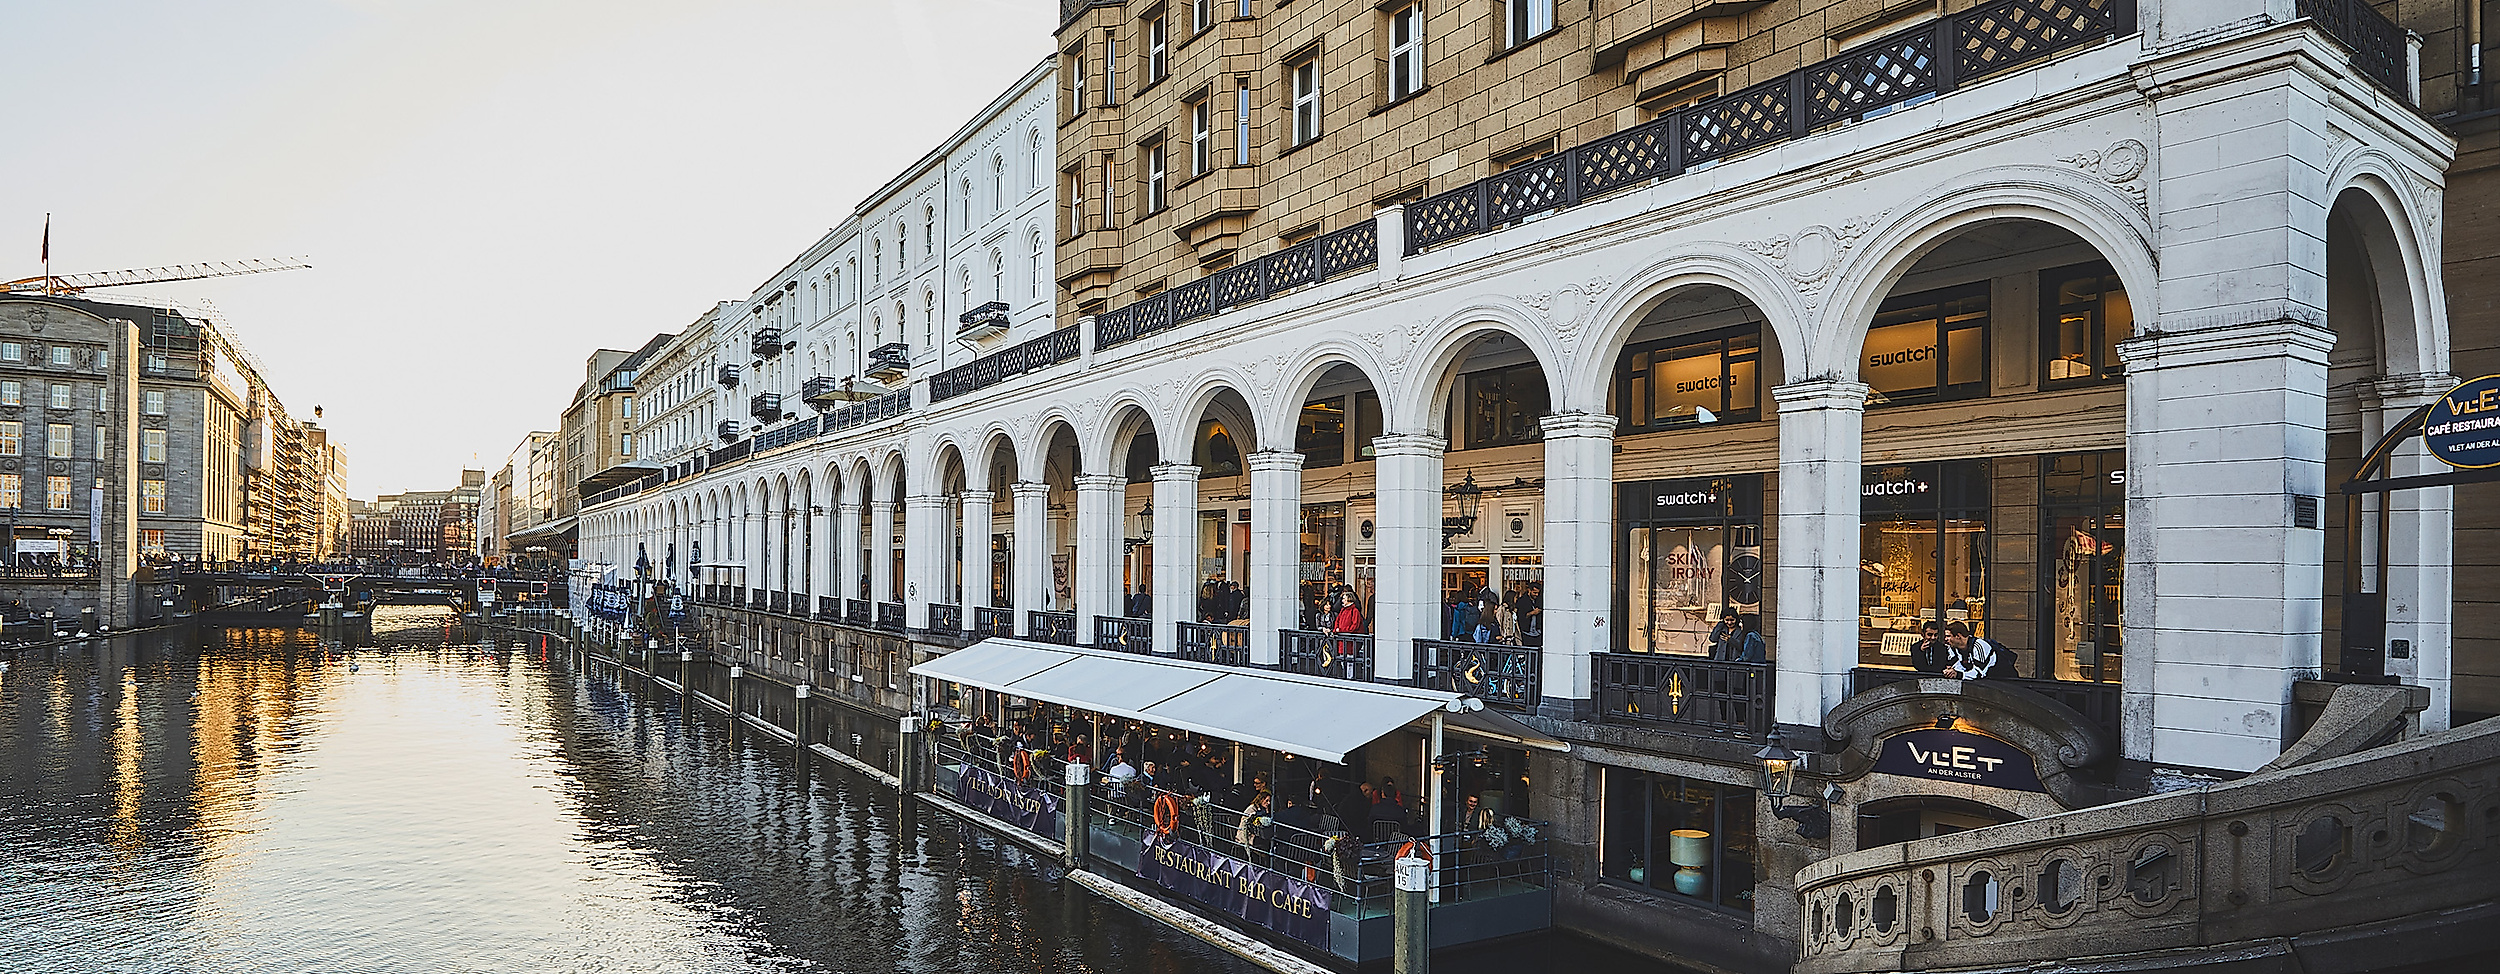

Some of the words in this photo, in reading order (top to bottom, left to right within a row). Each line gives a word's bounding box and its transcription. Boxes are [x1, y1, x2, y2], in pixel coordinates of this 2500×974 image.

[1869, 345, 1937, 368] swatch
[2446, 388, 2500, 416] VLE
[2427, 421, 2451, 436] CAFÉ
[2476, 440, 2491, 449] DER
[1861, 479, 1915, 496] watch
[1656, 491, 1707, 506] swatch
[1504, 568, 1543, 581] PREMIUM
[1672, 567, 1715, 580] IRONY
[1907, 741, 2004, 772] VLET
[1927, 767, 1938, 775] AN
[1938, 769, 1954, 777] DER
[1954, 771, 1982, 780] ALSTER
[1154, 846, 1232, 889] RESTAURANT
[1238, 876, 1267, 903] BAR
[1271, 889, 1313, 919] CAFE
[1397, 875, 1407, 886] 15
